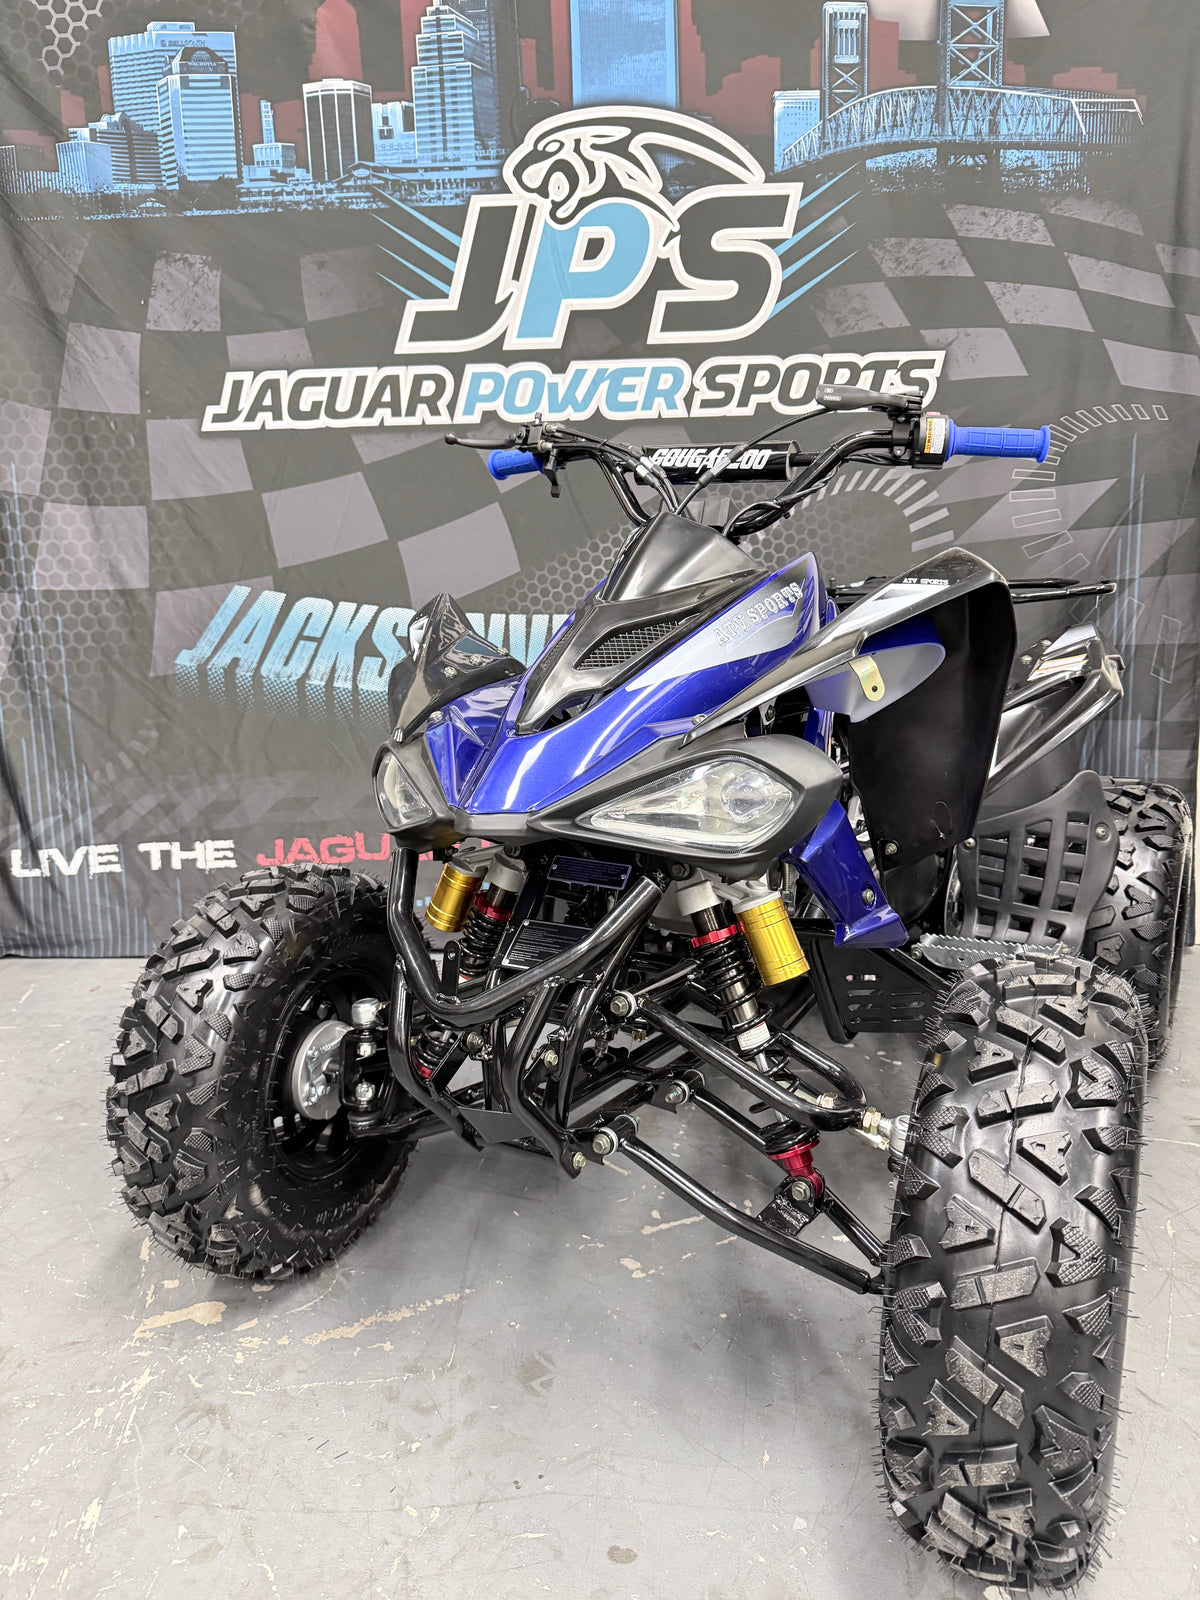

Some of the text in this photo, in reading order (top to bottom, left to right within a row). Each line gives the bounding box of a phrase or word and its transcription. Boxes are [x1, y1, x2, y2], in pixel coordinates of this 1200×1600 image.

[396, 184, 803, 353] JPS
[203, 364, 454, 430] JAGUAR
[455, 358, 690, 424] POWER
[713, 581, 804, 648] ATV SPORTS
[920, 577, 949, 586] SPORTS
[10, 844, 122, 879] LIVE
[137, 839, 239, 874] THE
